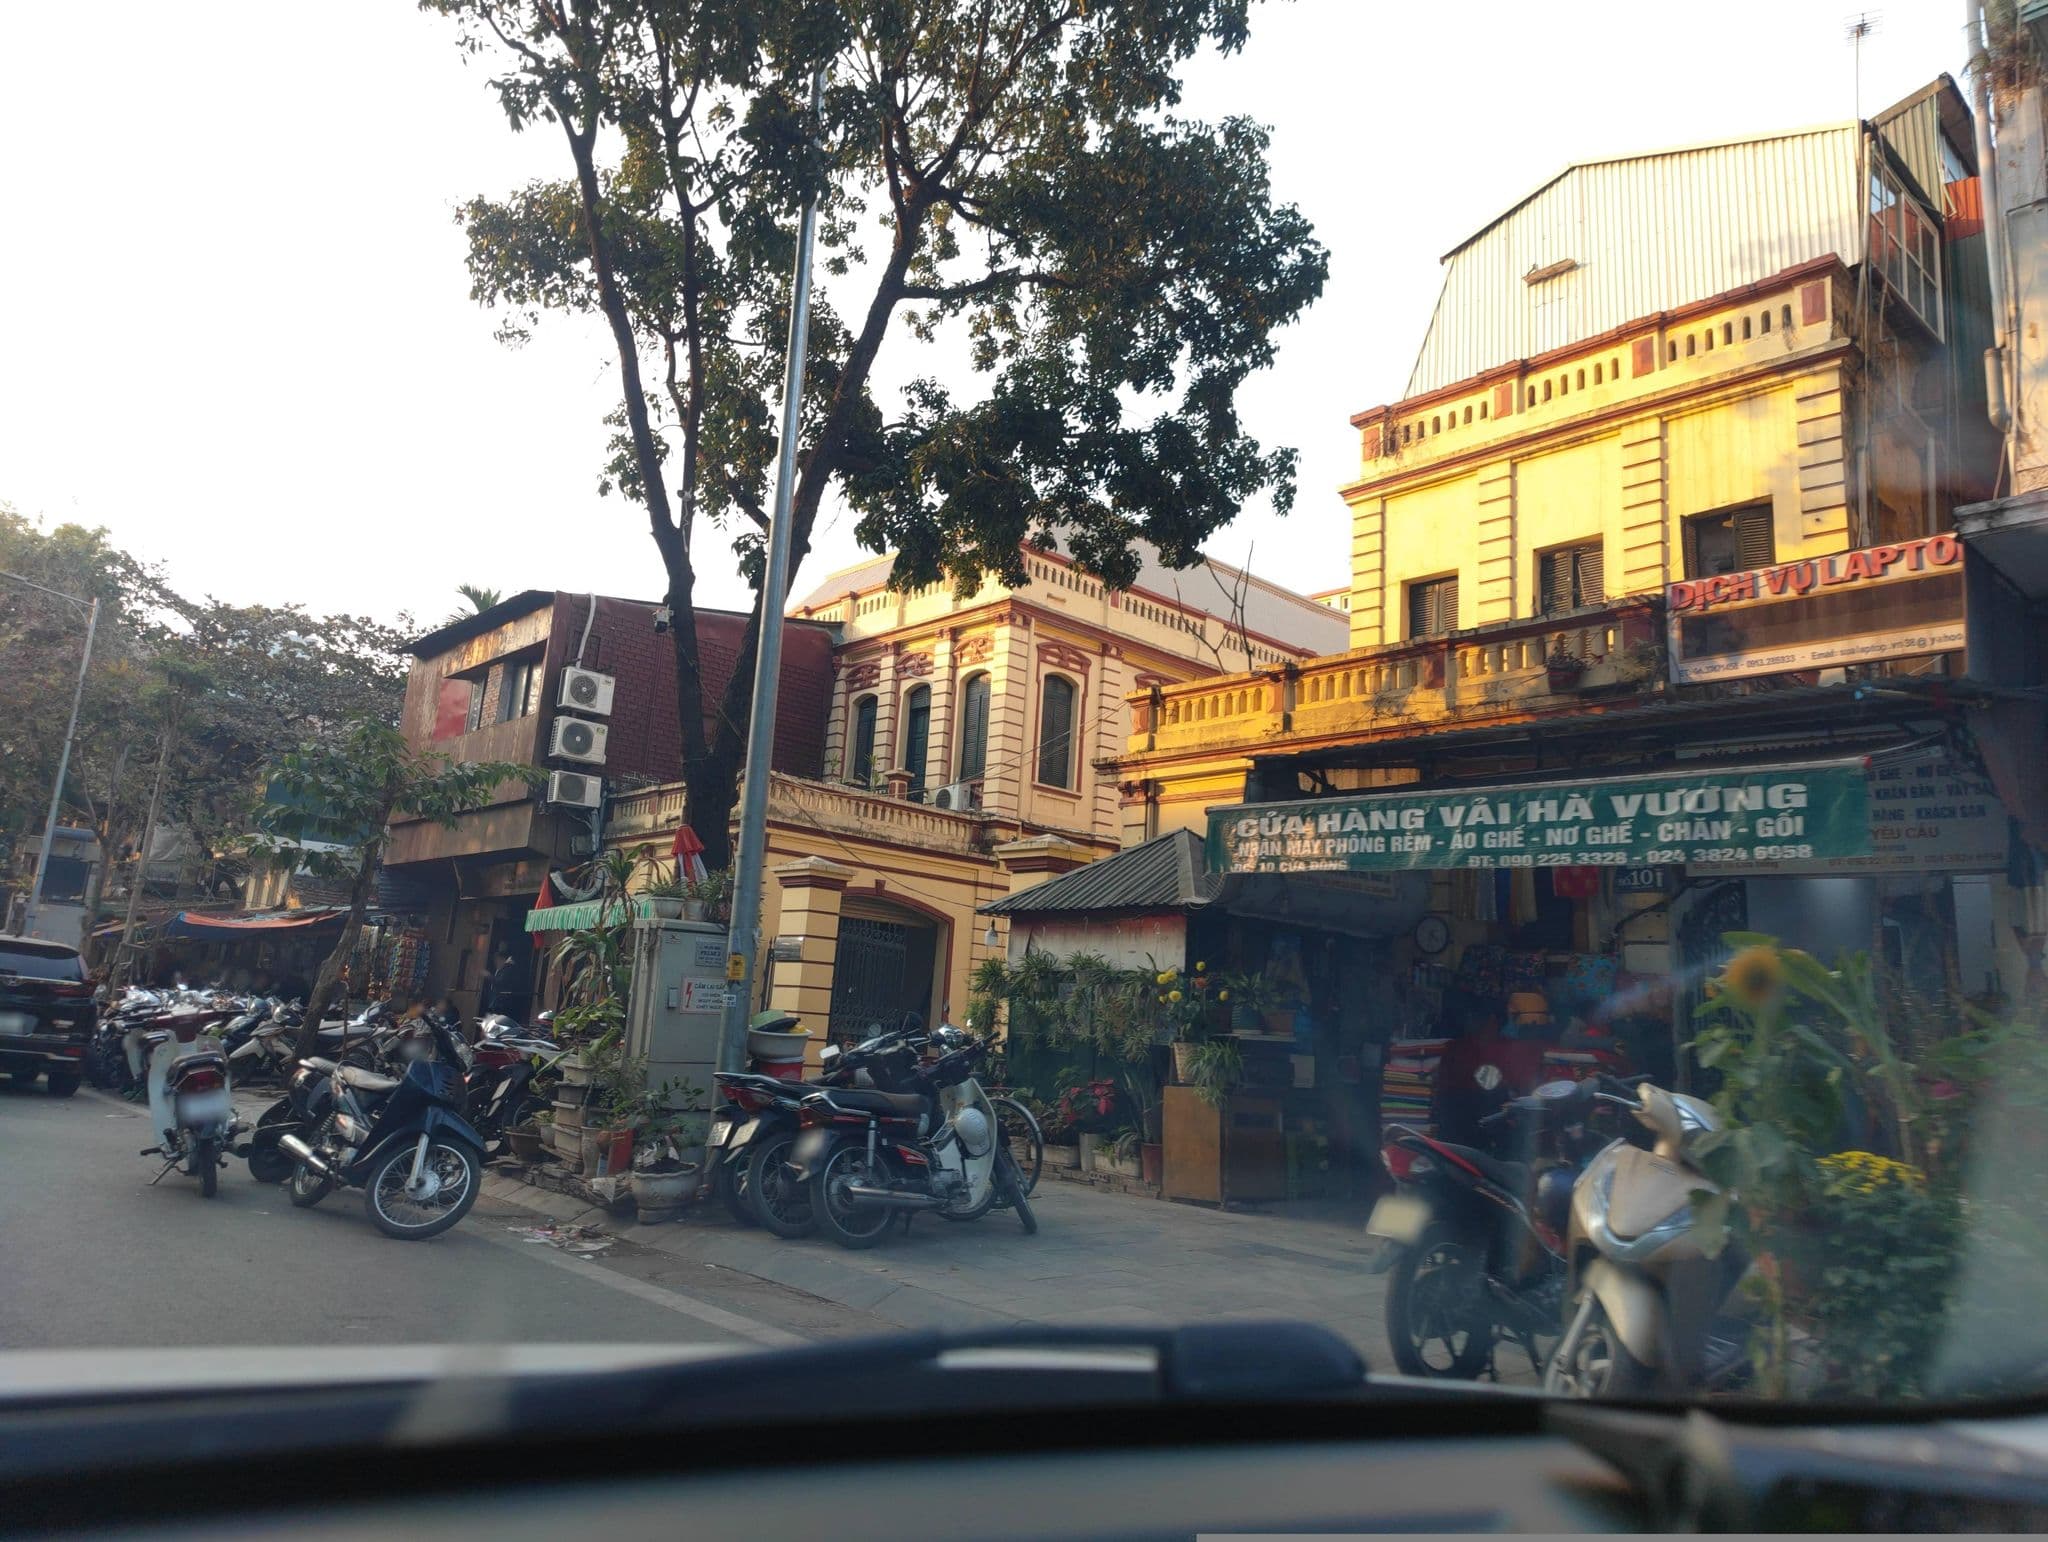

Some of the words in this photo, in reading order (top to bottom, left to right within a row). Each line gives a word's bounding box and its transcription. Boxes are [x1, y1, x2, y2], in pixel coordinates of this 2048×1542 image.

[1670, 572, 1756, 611] DỊCH
[1763, 561, 1813, 595] VỤ
[1317, 807, 1426, 833] HÀNG
[1439, 796, 1511, 828] VẢI
[1527, 793, 1595, 823] HÀ
[1328, 834, 1386, 854] PHÔNG
[1391, 832, 1432, 852] RÈM
[1483, 825, 1525, 848] GHẾ
[1586, 819, 1633, 845] GHẾ
[1657, 818, 1731, 842] CHĂN
[1756, 809, 1805, 838] GỐI
[1576, 850, 1628, 865] 3328
[1696, 847, 1748, 862] 3824
[1753, 844, 1814, 860] 6958
